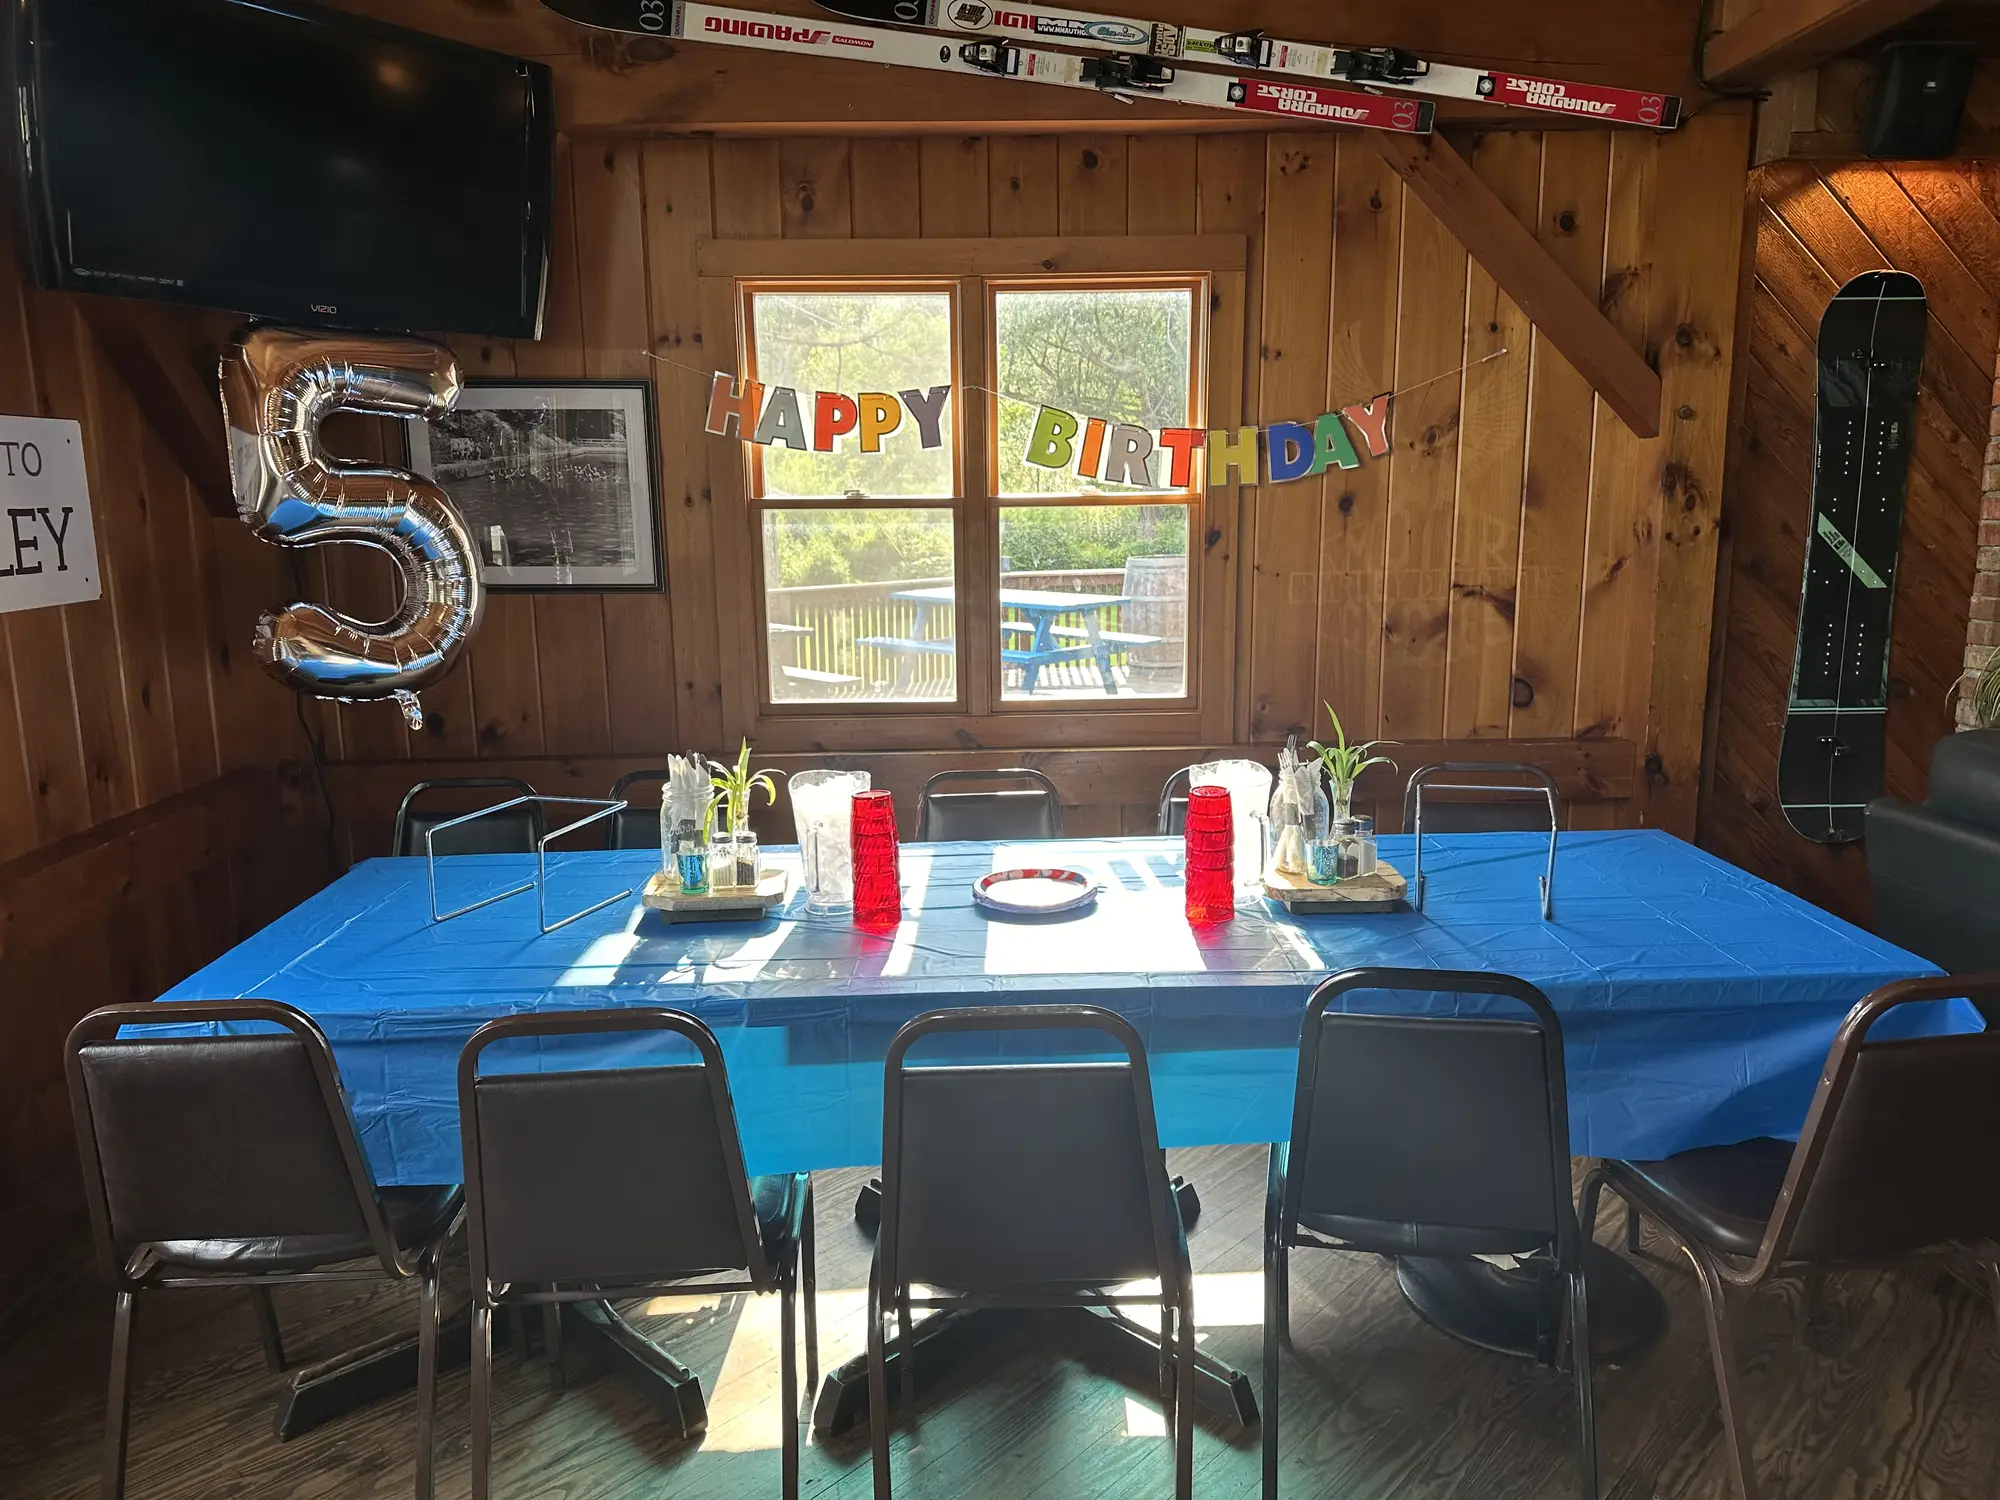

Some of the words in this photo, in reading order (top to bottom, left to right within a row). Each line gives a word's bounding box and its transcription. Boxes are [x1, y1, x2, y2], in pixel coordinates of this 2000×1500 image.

[639, 0, 665, 31] 03
[704, 16, 831, 46] SPALDING
[834, 36, 873, 48] SALOMON
[1257, 83, 1318, 103] CORSE
[1506, 77, 1566, 98] CORSE
[1391, 101, 1416, 129] 03
[1637, 95, 1663, 124] 03
[310, 304, 338, 315] VIZIO
[705, 370, 952, 454] HAPPY
[1025, 392, 1393, 488] BIRTHDAY
[0, 442, 42, 477] TO
